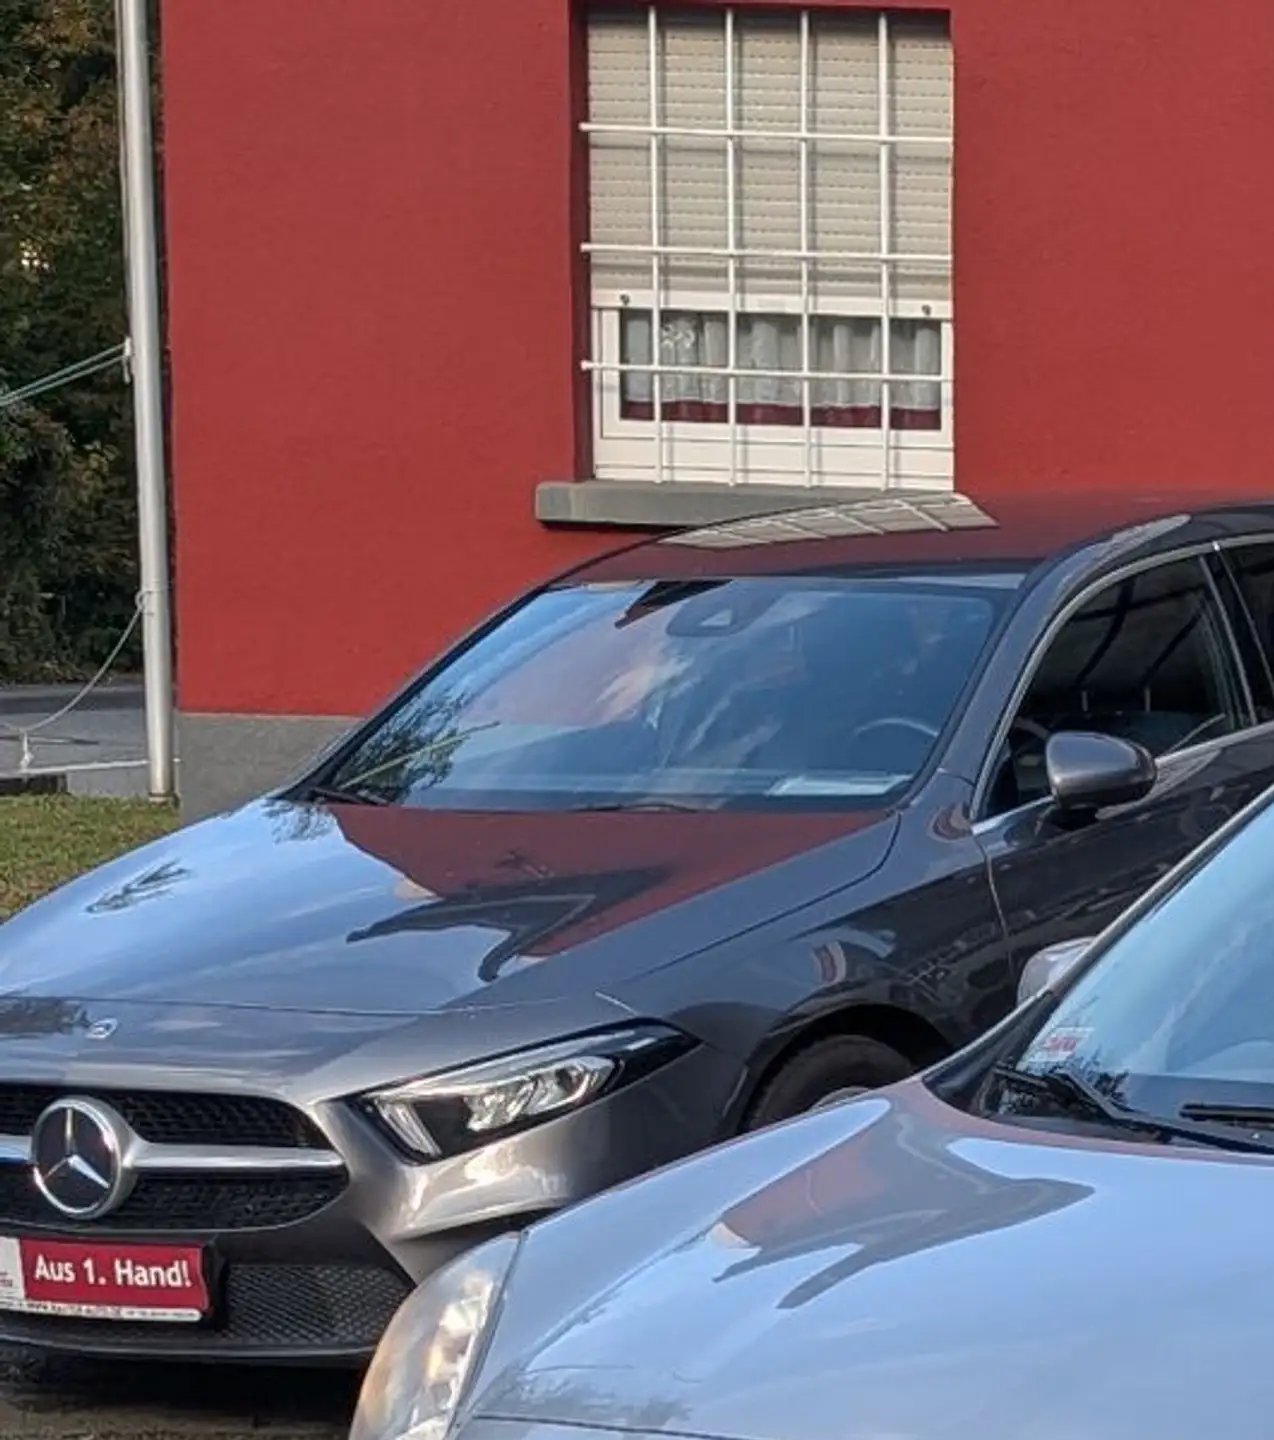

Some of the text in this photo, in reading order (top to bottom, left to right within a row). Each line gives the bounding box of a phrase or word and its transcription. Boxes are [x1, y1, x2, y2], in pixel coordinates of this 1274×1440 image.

[35, 1254, 76, 1283] Aus
[83, 1258, 107, 1286] 1.
[114, 1259, 193, 1288] Hand!
